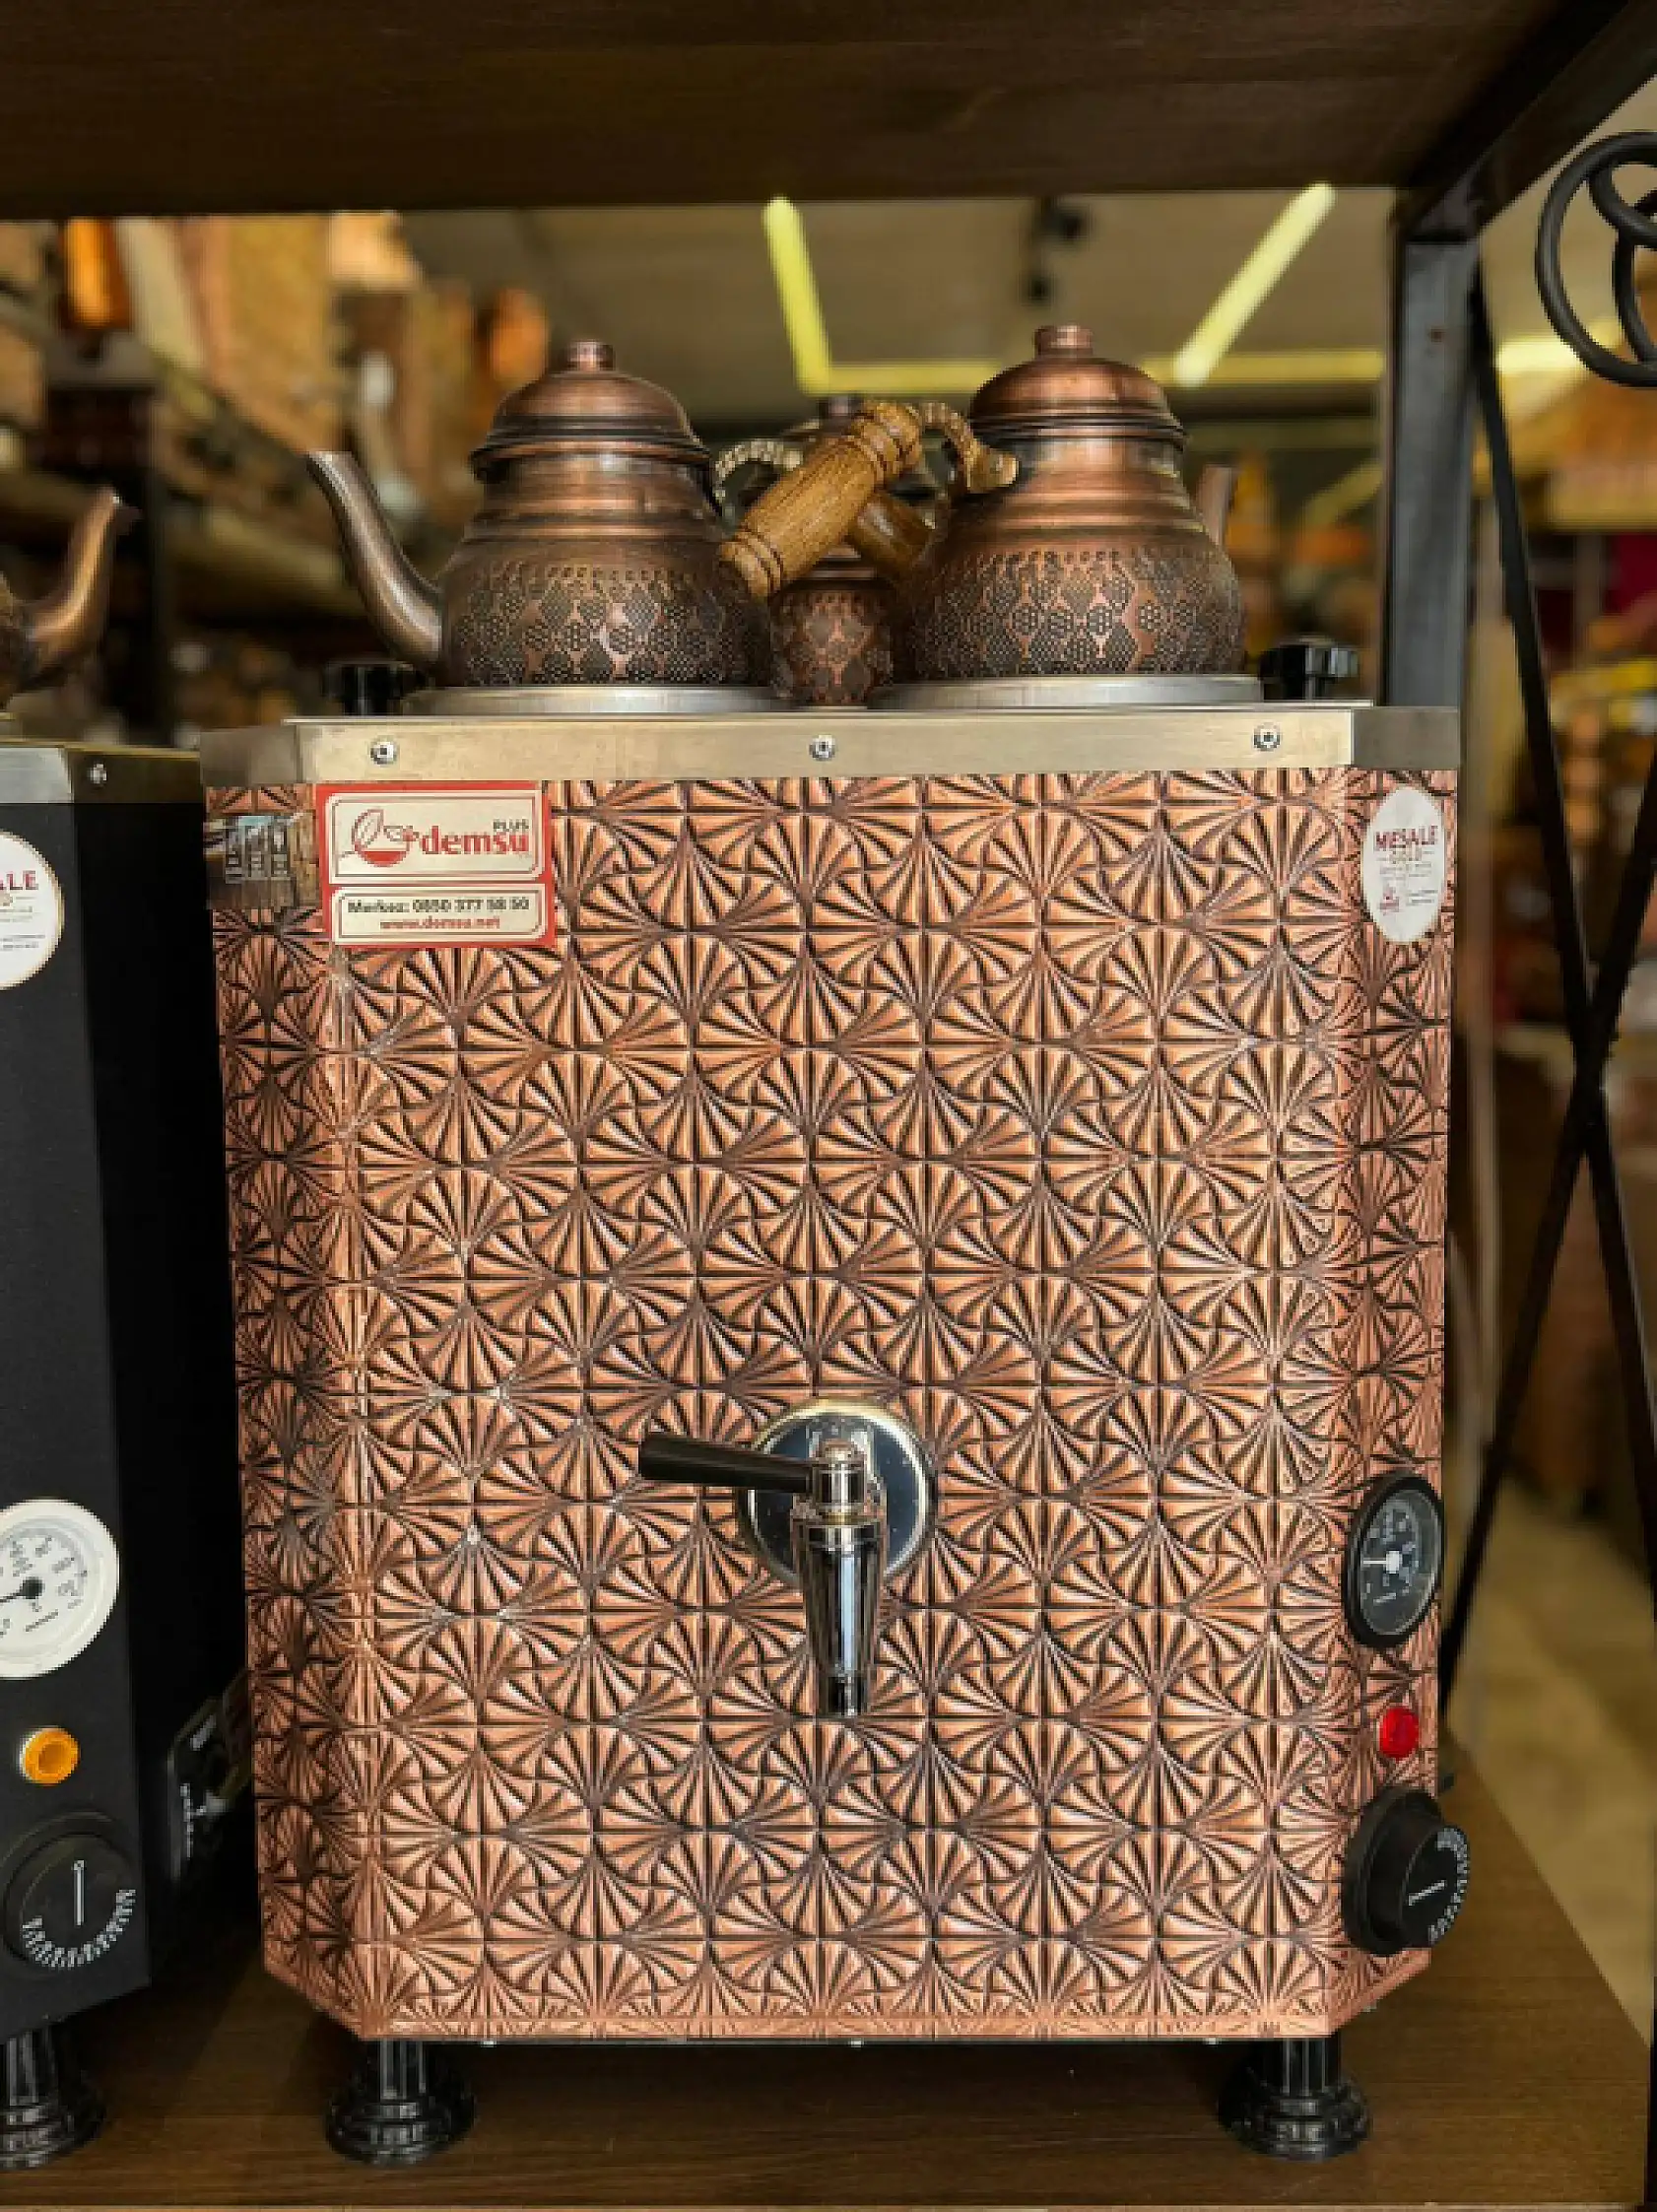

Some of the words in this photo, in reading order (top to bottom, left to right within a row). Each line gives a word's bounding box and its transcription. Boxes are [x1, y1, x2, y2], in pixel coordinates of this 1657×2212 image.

[421, 826, 529, 854] demsu
[413, 900, 451, 912] 0850
[455, 899, 484, 912] 377
[380, 916, 499, 929] www.demsu.net
